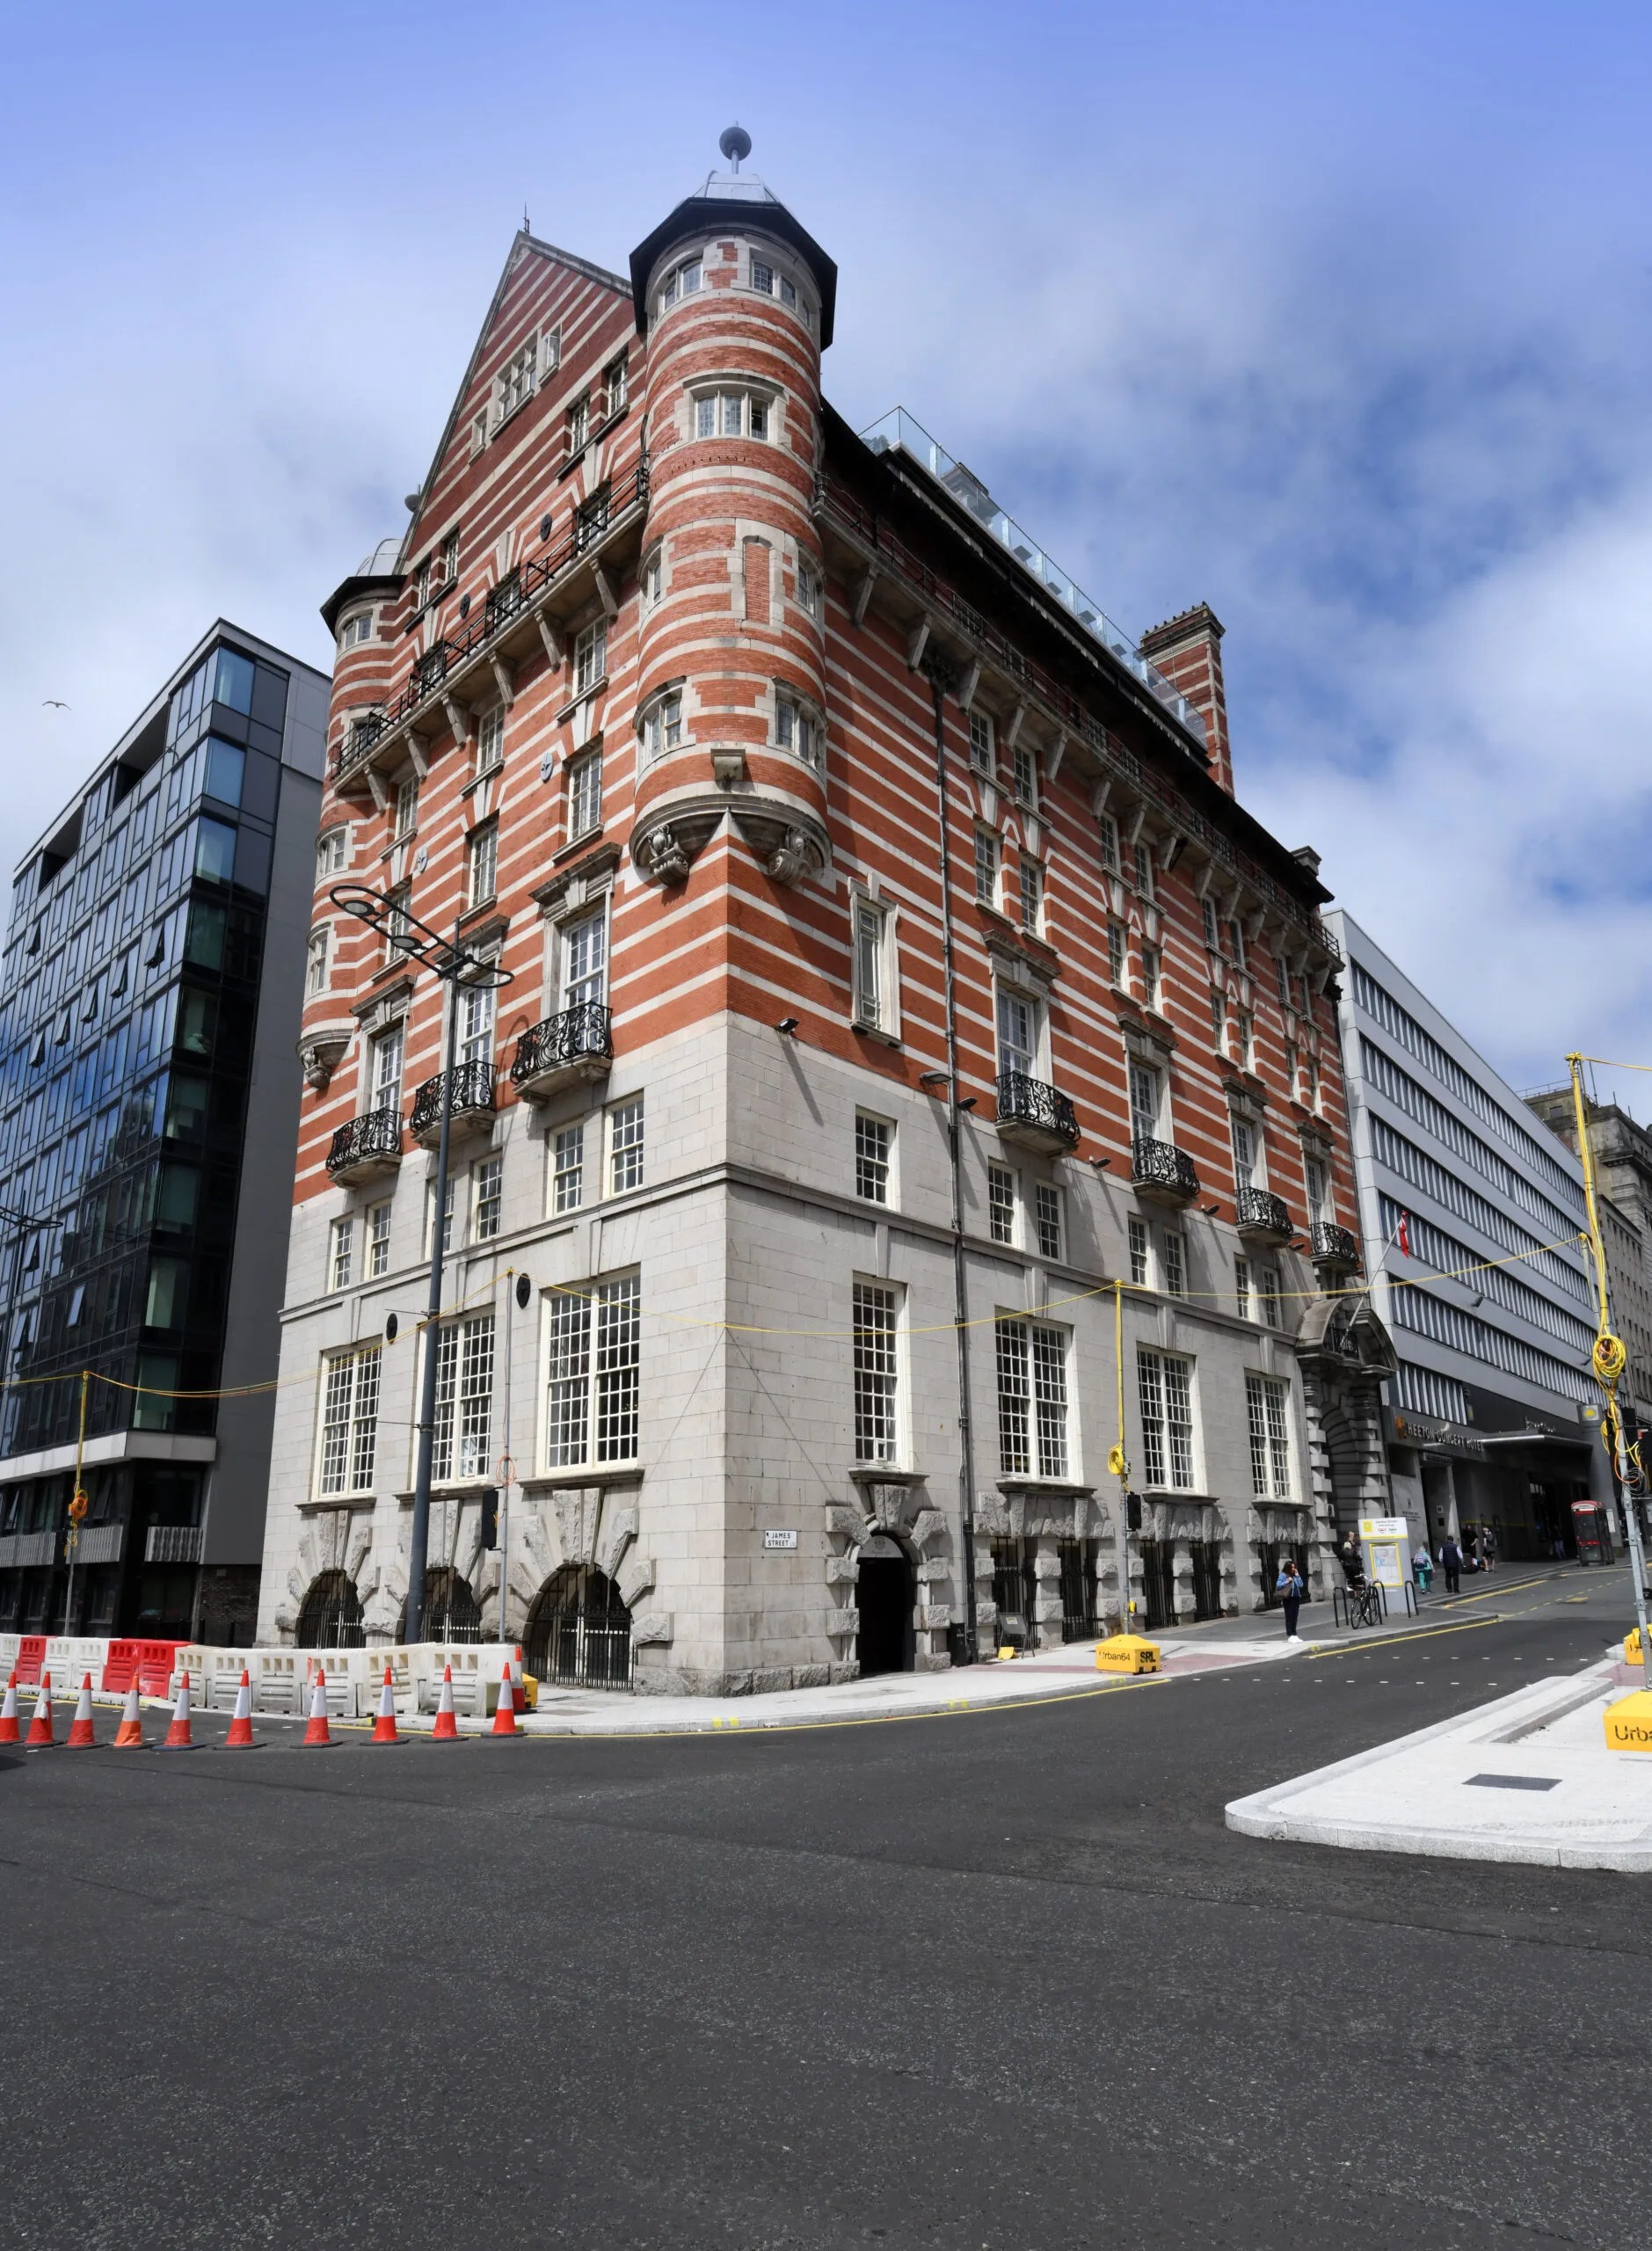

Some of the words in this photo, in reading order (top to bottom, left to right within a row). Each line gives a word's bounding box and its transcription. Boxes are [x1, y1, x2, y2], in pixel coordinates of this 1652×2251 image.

[1408, 1422, 1435, 1440] HEETON
[1437, 1429, 1465, 1448] CONCEPT
[1466, 1436, 1485, 1451] HOTEL
[1140, 1651, 1156, 1663] SRL
